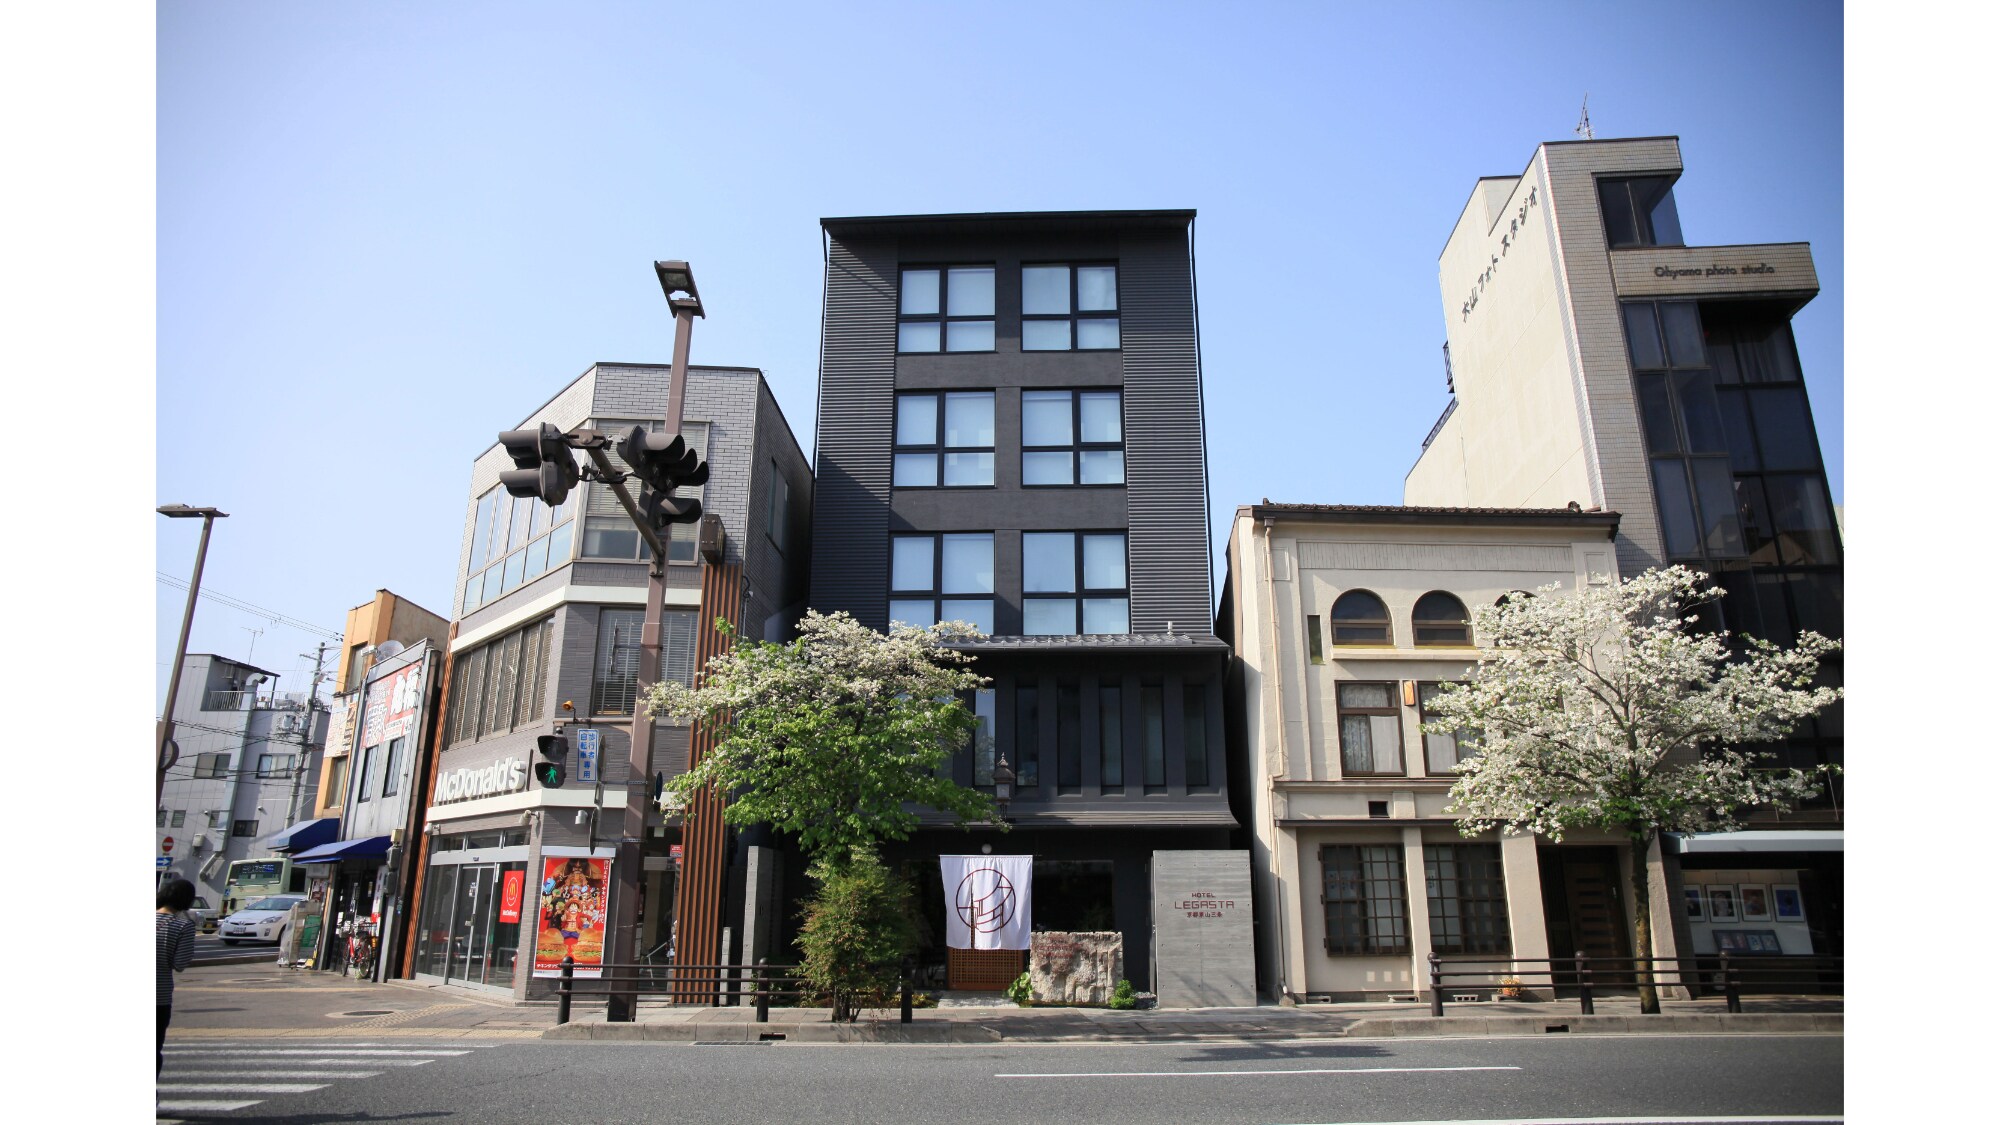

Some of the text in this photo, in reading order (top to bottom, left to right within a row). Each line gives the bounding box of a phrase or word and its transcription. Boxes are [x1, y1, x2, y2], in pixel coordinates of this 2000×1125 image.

[1654, 262, 1775, 280] Ohyama photo studio
[433, 757, 525, 803] McDonald's
[1174, 900, 1235, 910] LEGASTA
